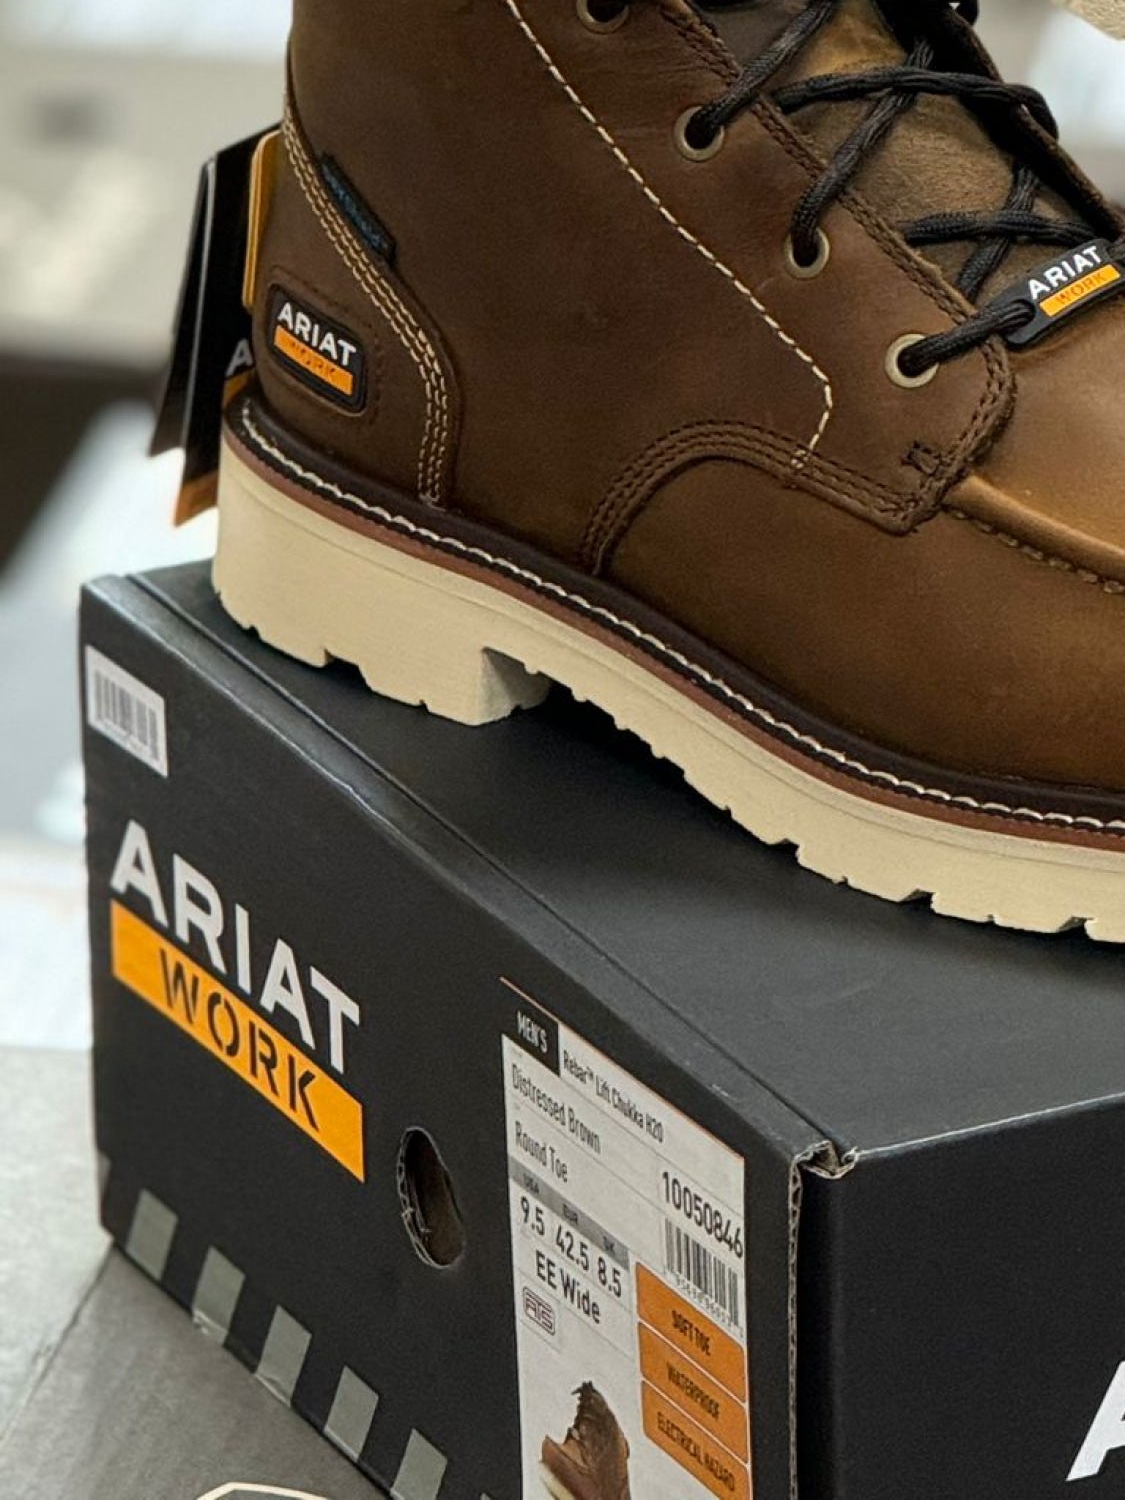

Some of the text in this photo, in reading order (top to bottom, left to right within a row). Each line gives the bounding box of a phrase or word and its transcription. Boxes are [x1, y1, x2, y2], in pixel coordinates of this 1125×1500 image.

[1028, 245, 1103, 300] ARIAT
[1054, 272, 1106, 305] WORK
[276, 301, 357, 366] ARIAT
[109, 818, 361, 1076] ARIAT
[159, 945, 322, 1133] WORK
[516, 1010, 548, 1053] MEN'S
[511, 1063, 601, 1154] Distressed Brown
[514, 1120, 569, 1183] Round Toe
[520, 1195, 622, 1299] 9.5 42.5 8.5
[661, 1171, 744, 1260] 10050846
[535, 1250, 601, 1325] EE Wide
[666, 1361, 720, 1422] WATERPROOF
[657, 1410, 704, 1465] ELECTRICAL
